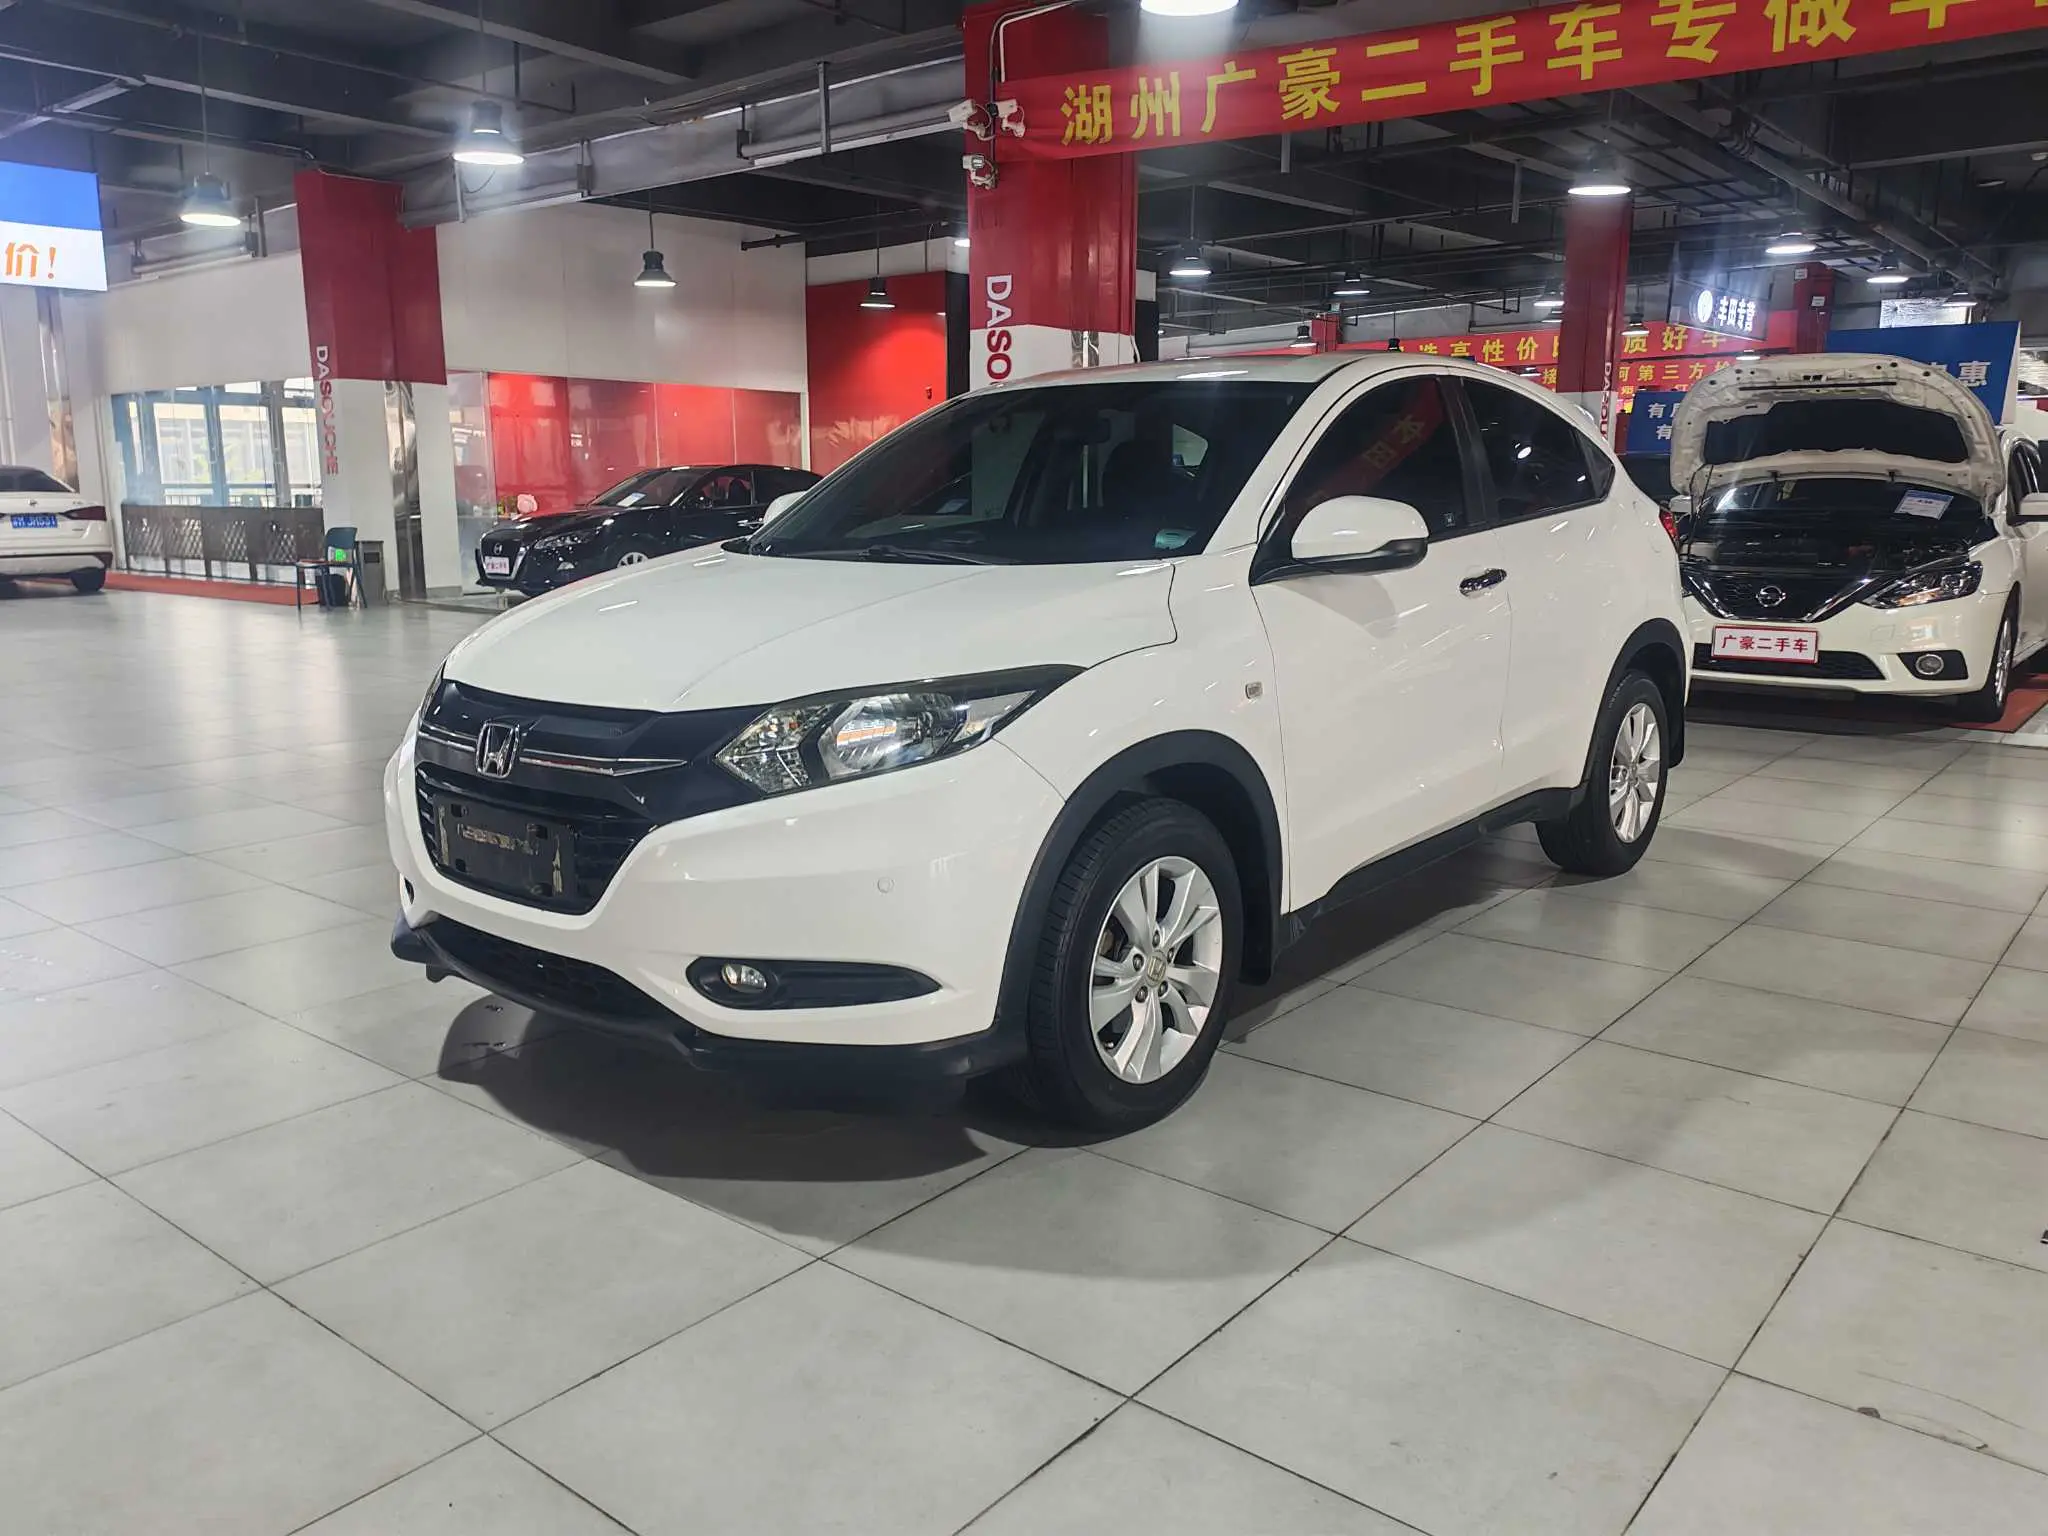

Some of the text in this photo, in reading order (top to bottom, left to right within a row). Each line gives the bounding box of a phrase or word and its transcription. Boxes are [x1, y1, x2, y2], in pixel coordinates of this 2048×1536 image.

[1060, 0, 2048, 146] 湖州广豪二手车专做
[986, 274, 1013, 388] DASO
[1720, 634, 1809, 654] 广豪二手车
